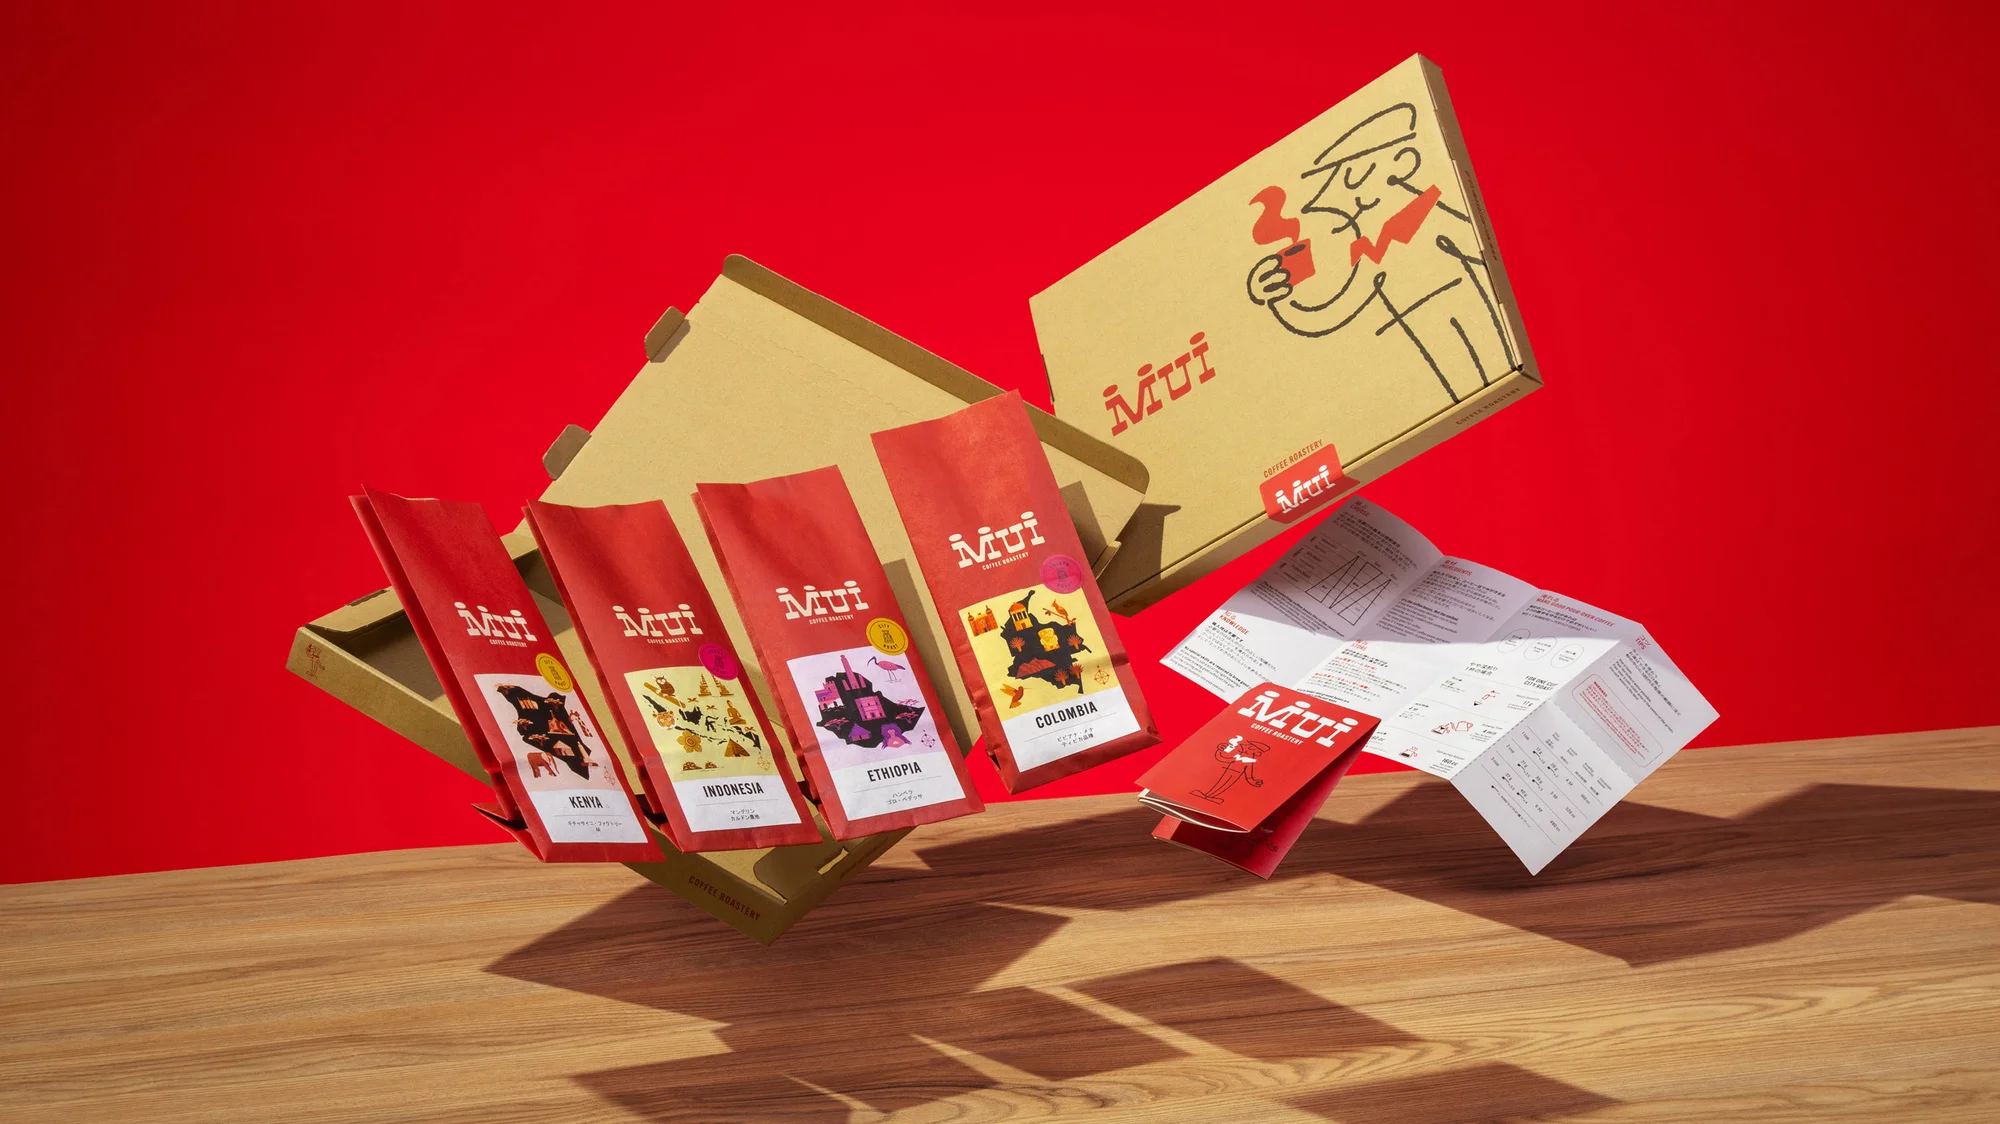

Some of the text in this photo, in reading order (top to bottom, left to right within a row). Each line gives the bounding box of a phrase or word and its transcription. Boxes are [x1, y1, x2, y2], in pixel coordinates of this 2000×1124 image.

[1263, 438, 1324, 479] COFFEE ROASTERY
[982, 552, 1030, 571] COFFEE ROASTERY
[1439, 562, 1473, 576] INGREDIENTS
[809, 614, 854, 625] COFFEE ROASTERY
[1535, 596, 1614, 626] MAKE GOOD POUR-OVER COFFEE
[1218, 614, 1249, 635] KNOWLEDGE
[1350, 642, 1367, 651] STORE
[1635, 638, 1646, 650] TIPS
[1639, 634, 1650, 646] コツ
[1535, 683, 1553, 691] ROAST
[1035, 701, 1098, 729] COLOMBIA
[1250, 722, 1304, 746] COFFEE ROASTERY
[867, 761, 922, 782] ETHIOPIA
[702, 782, 764, 798] INDONESIA
[568, 796, 604, 809] KENYA
[688, 875, 761, 921] COFFEE ROASTERY
